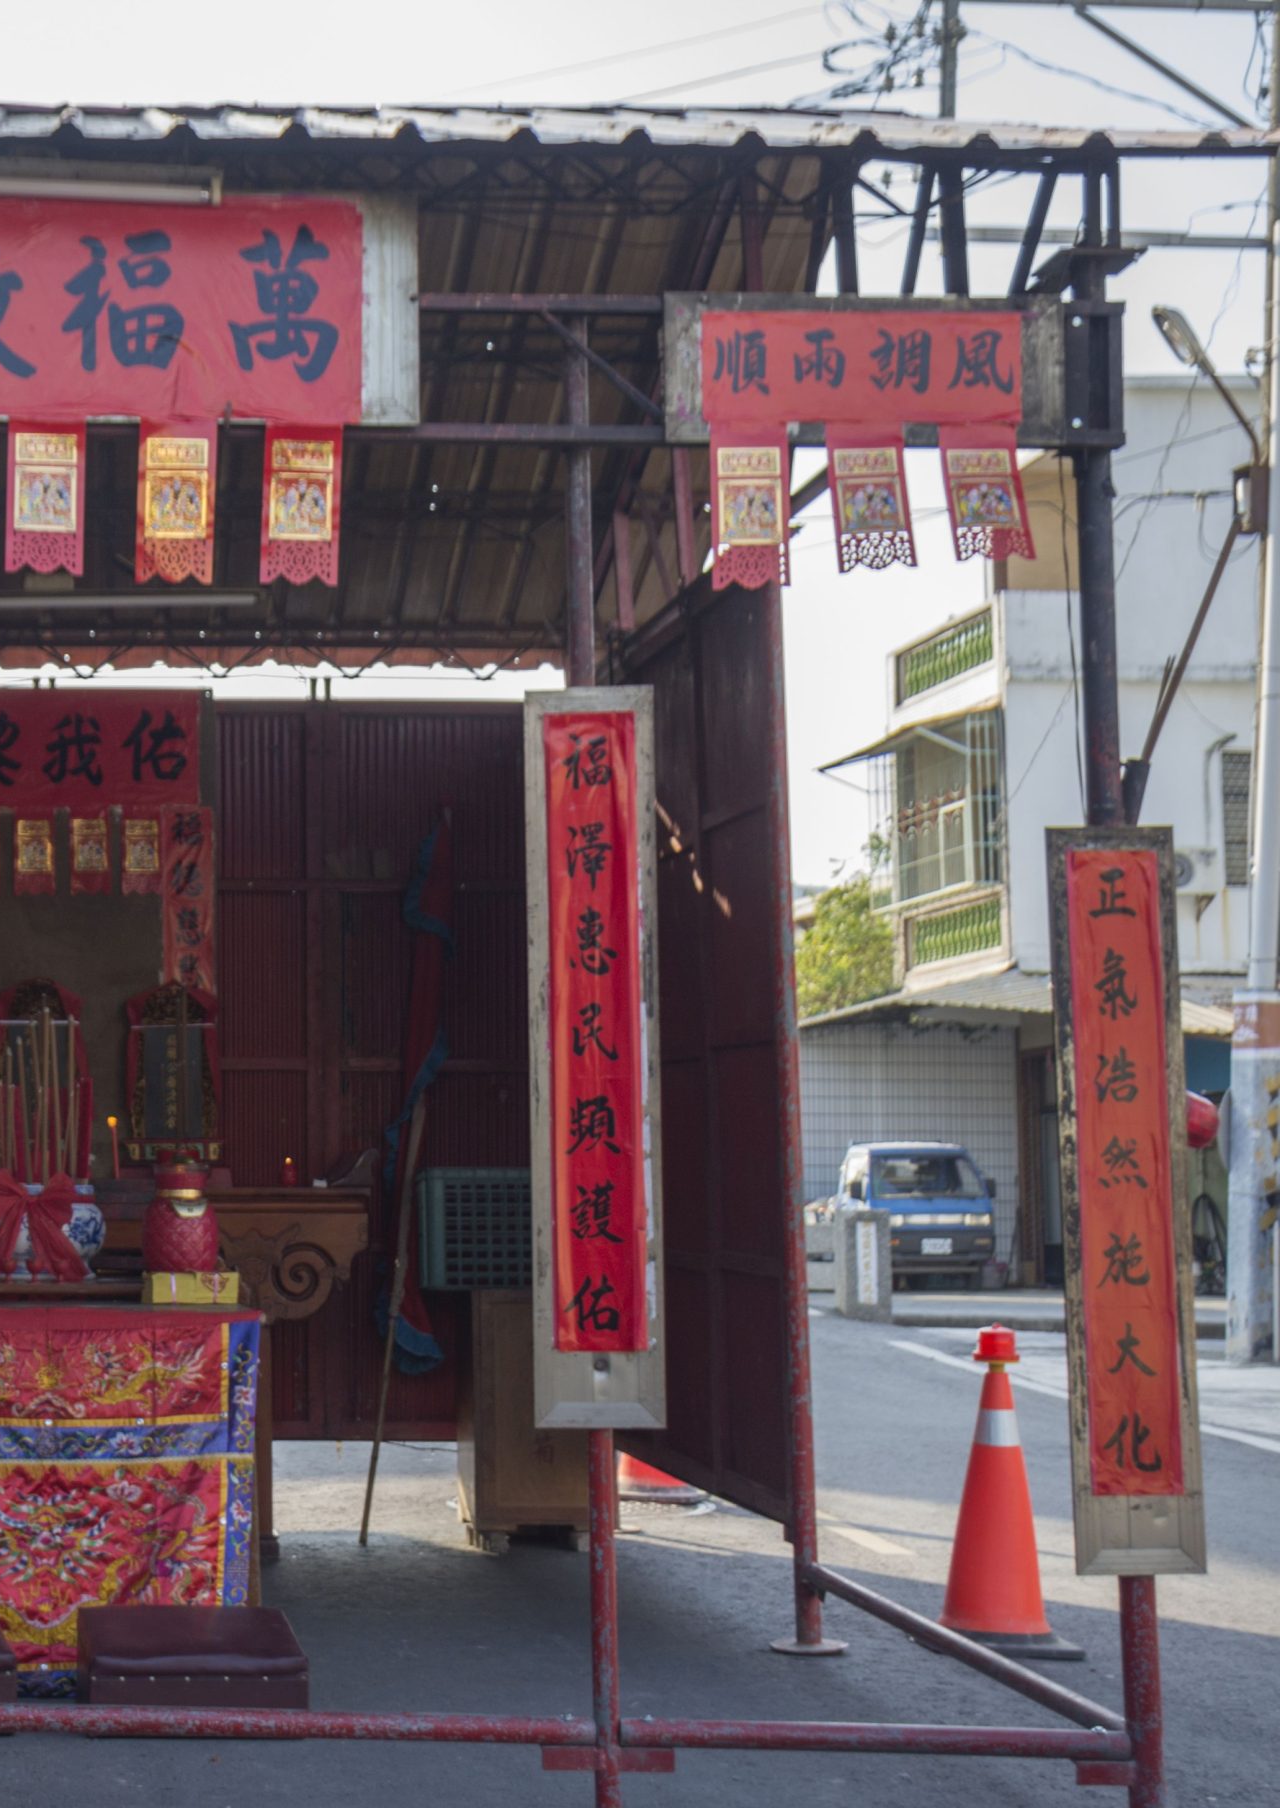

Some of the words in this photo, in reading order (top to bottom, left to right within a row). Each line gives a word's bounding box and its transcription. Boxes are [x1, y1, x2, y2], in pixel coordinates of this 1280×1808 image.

[713, 328, 1015, 396] 風調雨順
[563, 733, 626, 1333] 福澤惠民頻護佑
[1088, 867, 1163, 1474] 正氣浩然施大化
